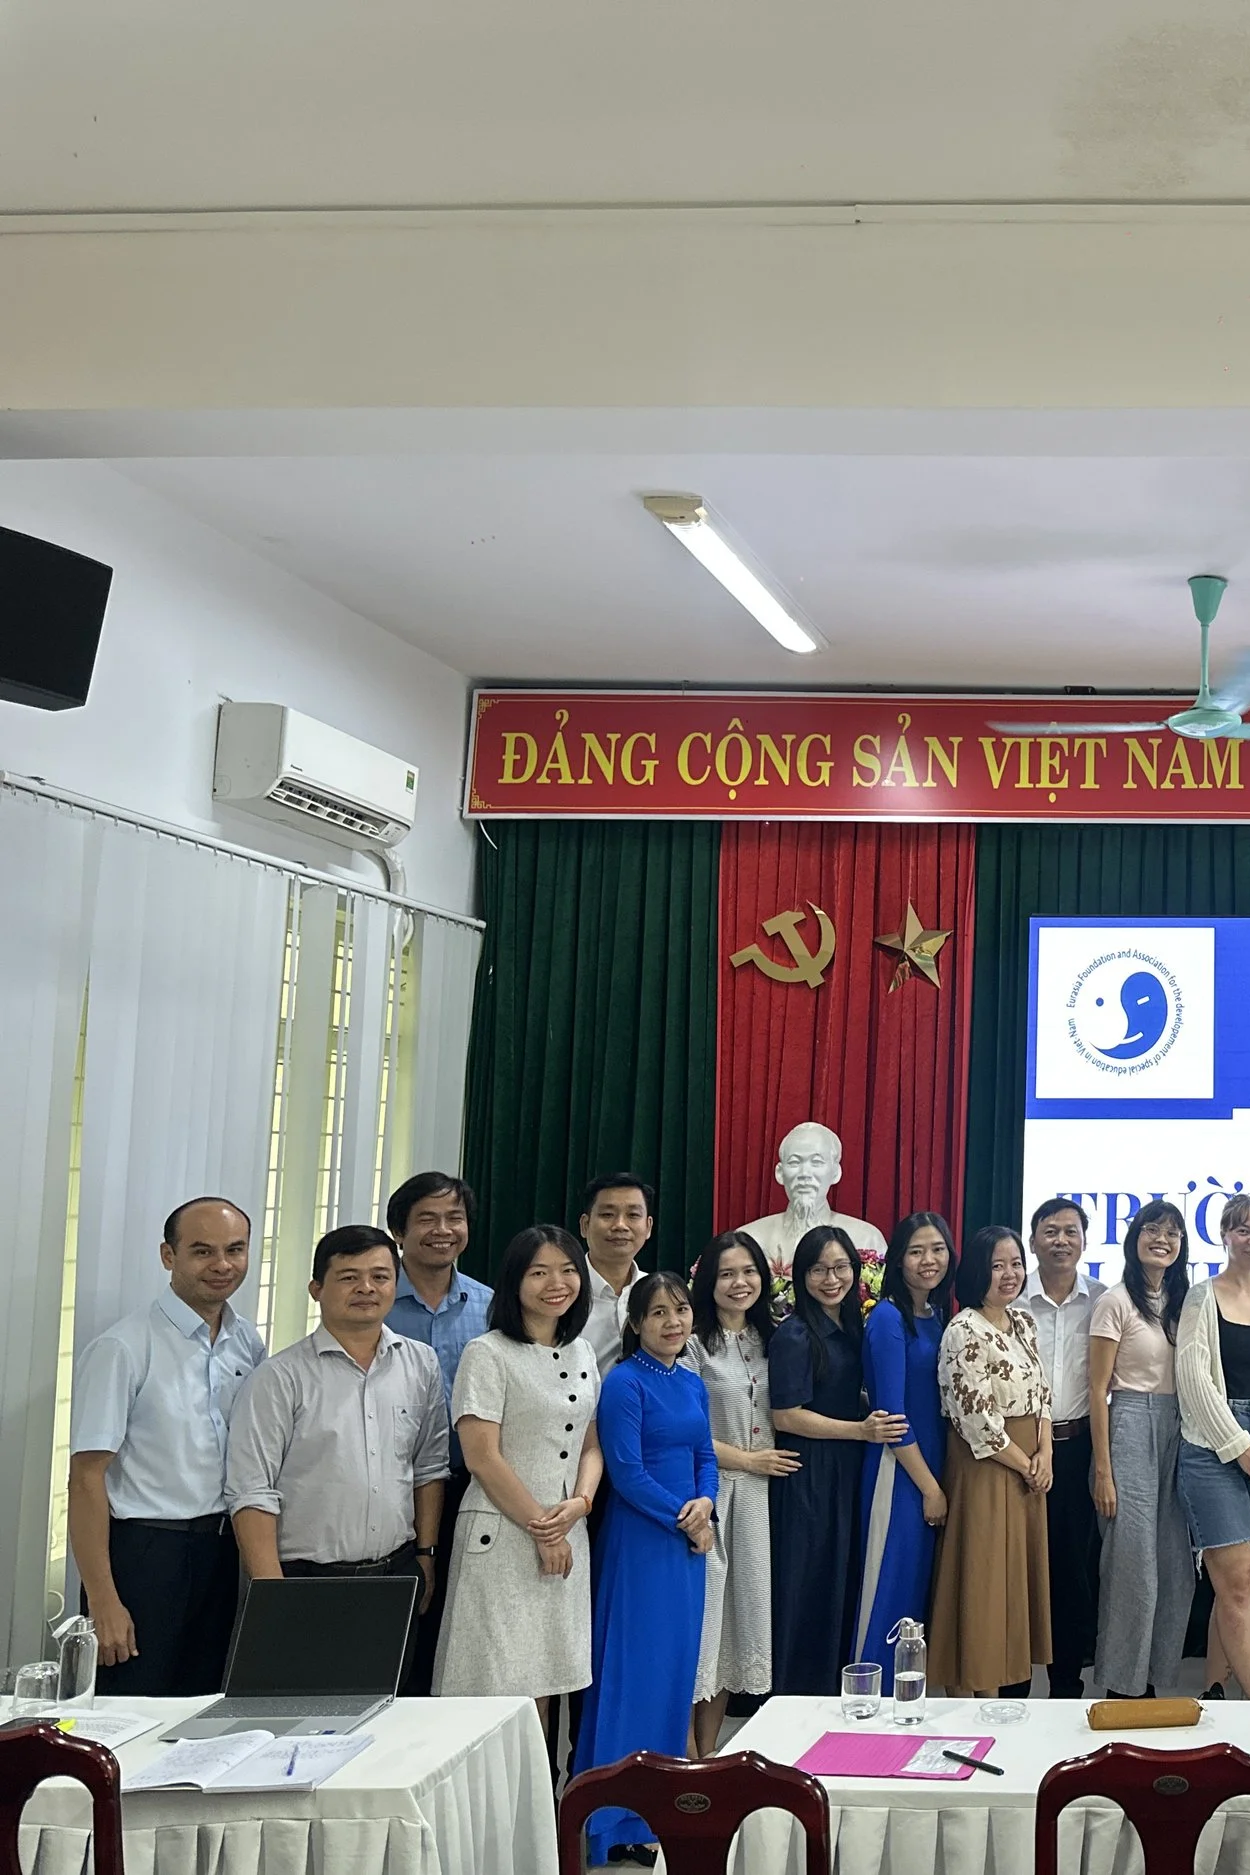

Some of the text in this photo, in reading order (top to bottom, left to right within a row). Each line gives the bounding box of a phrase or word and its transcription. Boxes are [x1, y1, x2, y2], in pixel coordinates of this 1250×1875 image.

[501, 709, 659, 785] ĐẢNG
[677, 717, 832, 800] CỘNG
[852, 713, 960, 788] SẢN
[978, 721, 1107, 803] VIỆT
[1123, 736, 1245, 790] NAM
[1117, 948, 1132, 959] and
[1078, 952, 1116, 982] Foundation
[1132, 949, 1171, 978] Association
[1168, 975, 1178, 988] for
[1066, 980, 1083, 1009] Eurasia
[1172, 987, 1183, 1002] the
[1085, 1051, 1093, 1064] in
[1091, 1057, 1128, 1077] education
[1153, 1053, 1162, 1066] of
[1128, 1058, 1154, 1077] special
